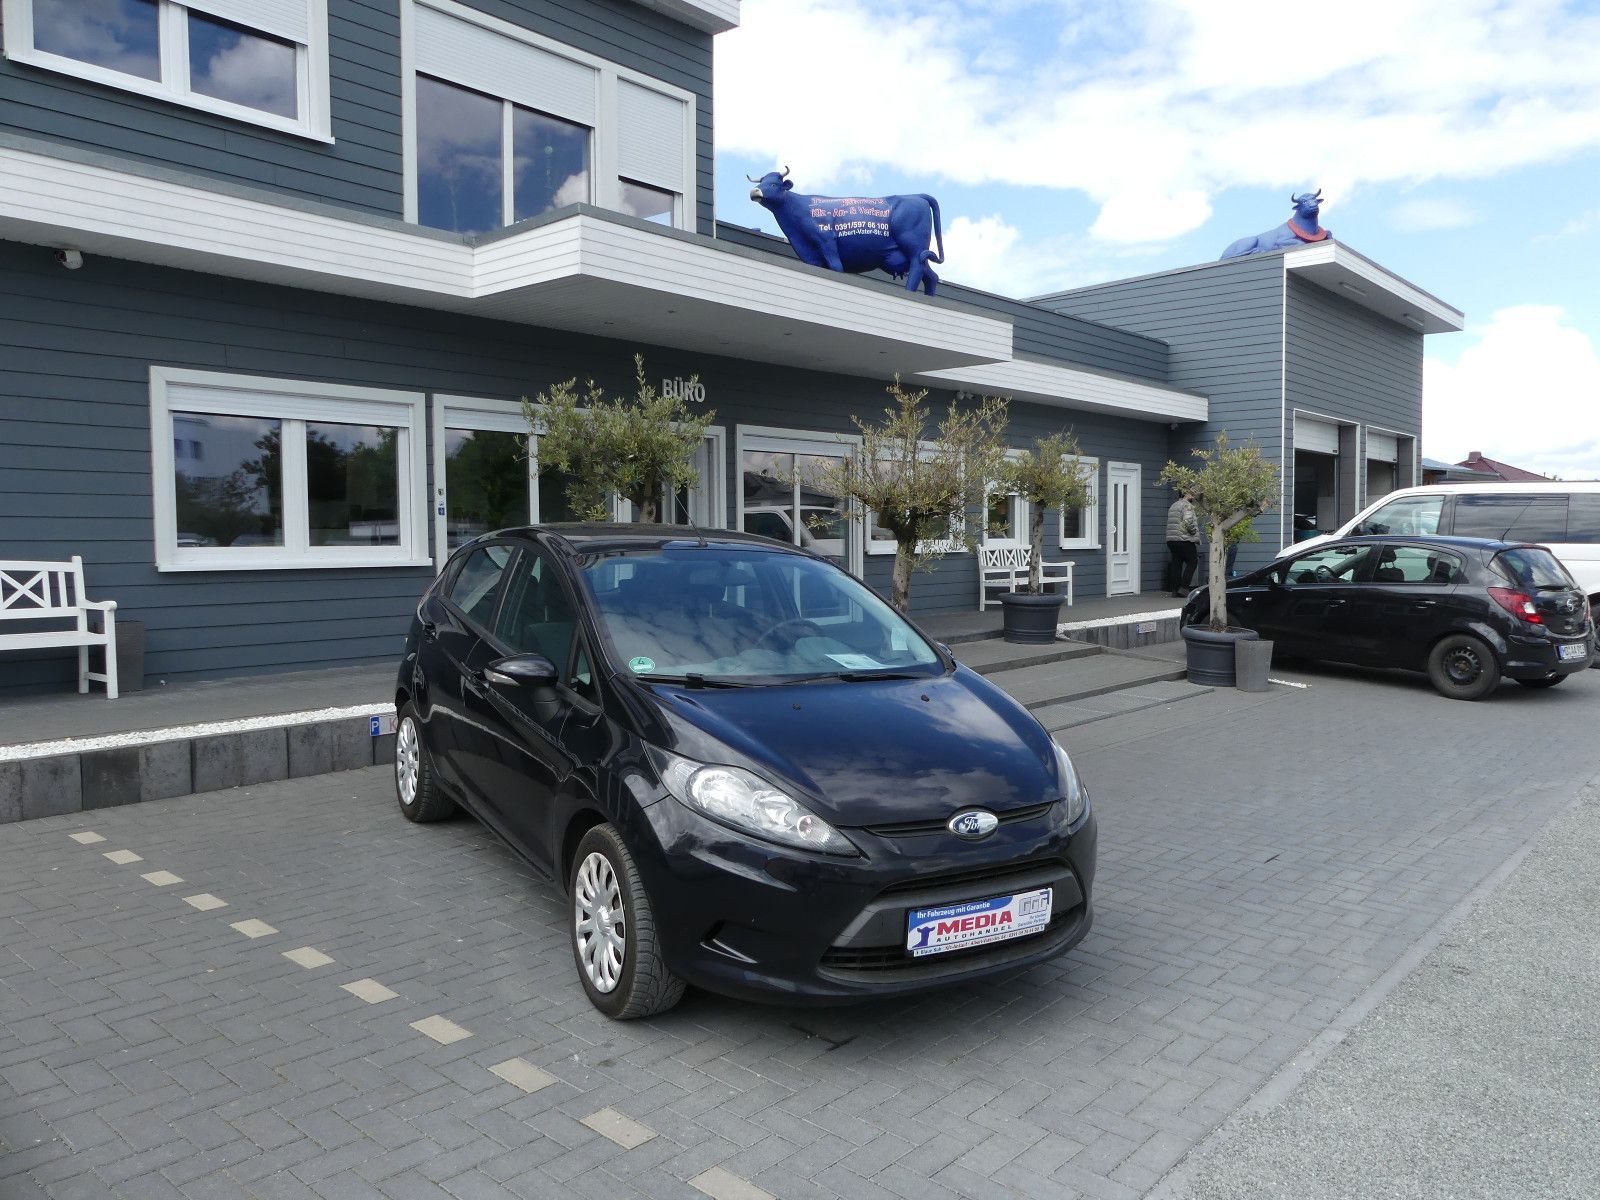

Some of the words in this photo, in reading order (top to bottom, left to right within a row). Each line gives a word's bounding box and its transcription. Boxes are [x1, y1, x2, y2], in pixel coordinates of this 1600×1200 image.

[835, 221, 867, 231] 0391/597
[663, 377, 706, 403] BÜRO
[917, 911, 926, 919] Ihr
[927, 908, 956, 918] Fahrzeug
[967, 902, 991, 911] Garantie
[937, 911, 1013, 935] MEDIA
[936, 925, 1012, 942] AUTOHANDEL
